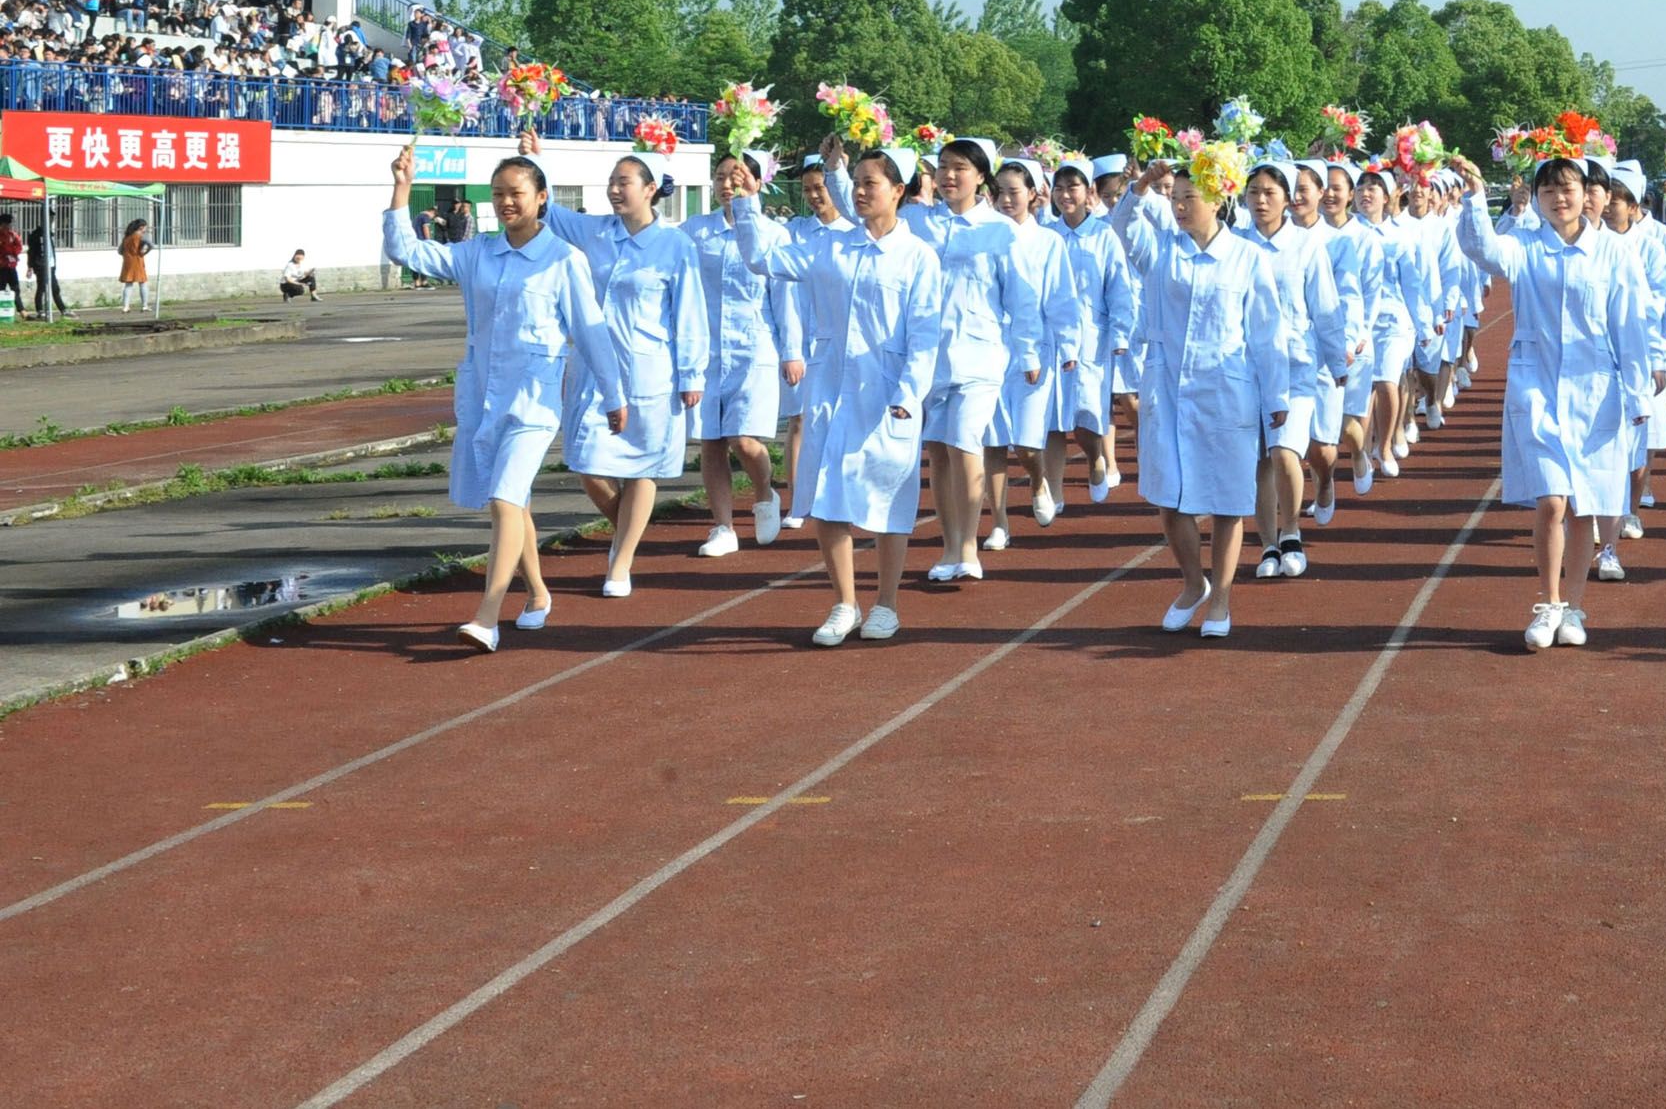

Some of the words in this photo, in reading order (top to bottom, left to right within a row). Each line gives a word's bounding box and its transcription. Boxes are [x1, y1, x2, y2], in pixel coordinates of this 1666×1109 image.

[45, 126, 241, 170] 更快更高更强
